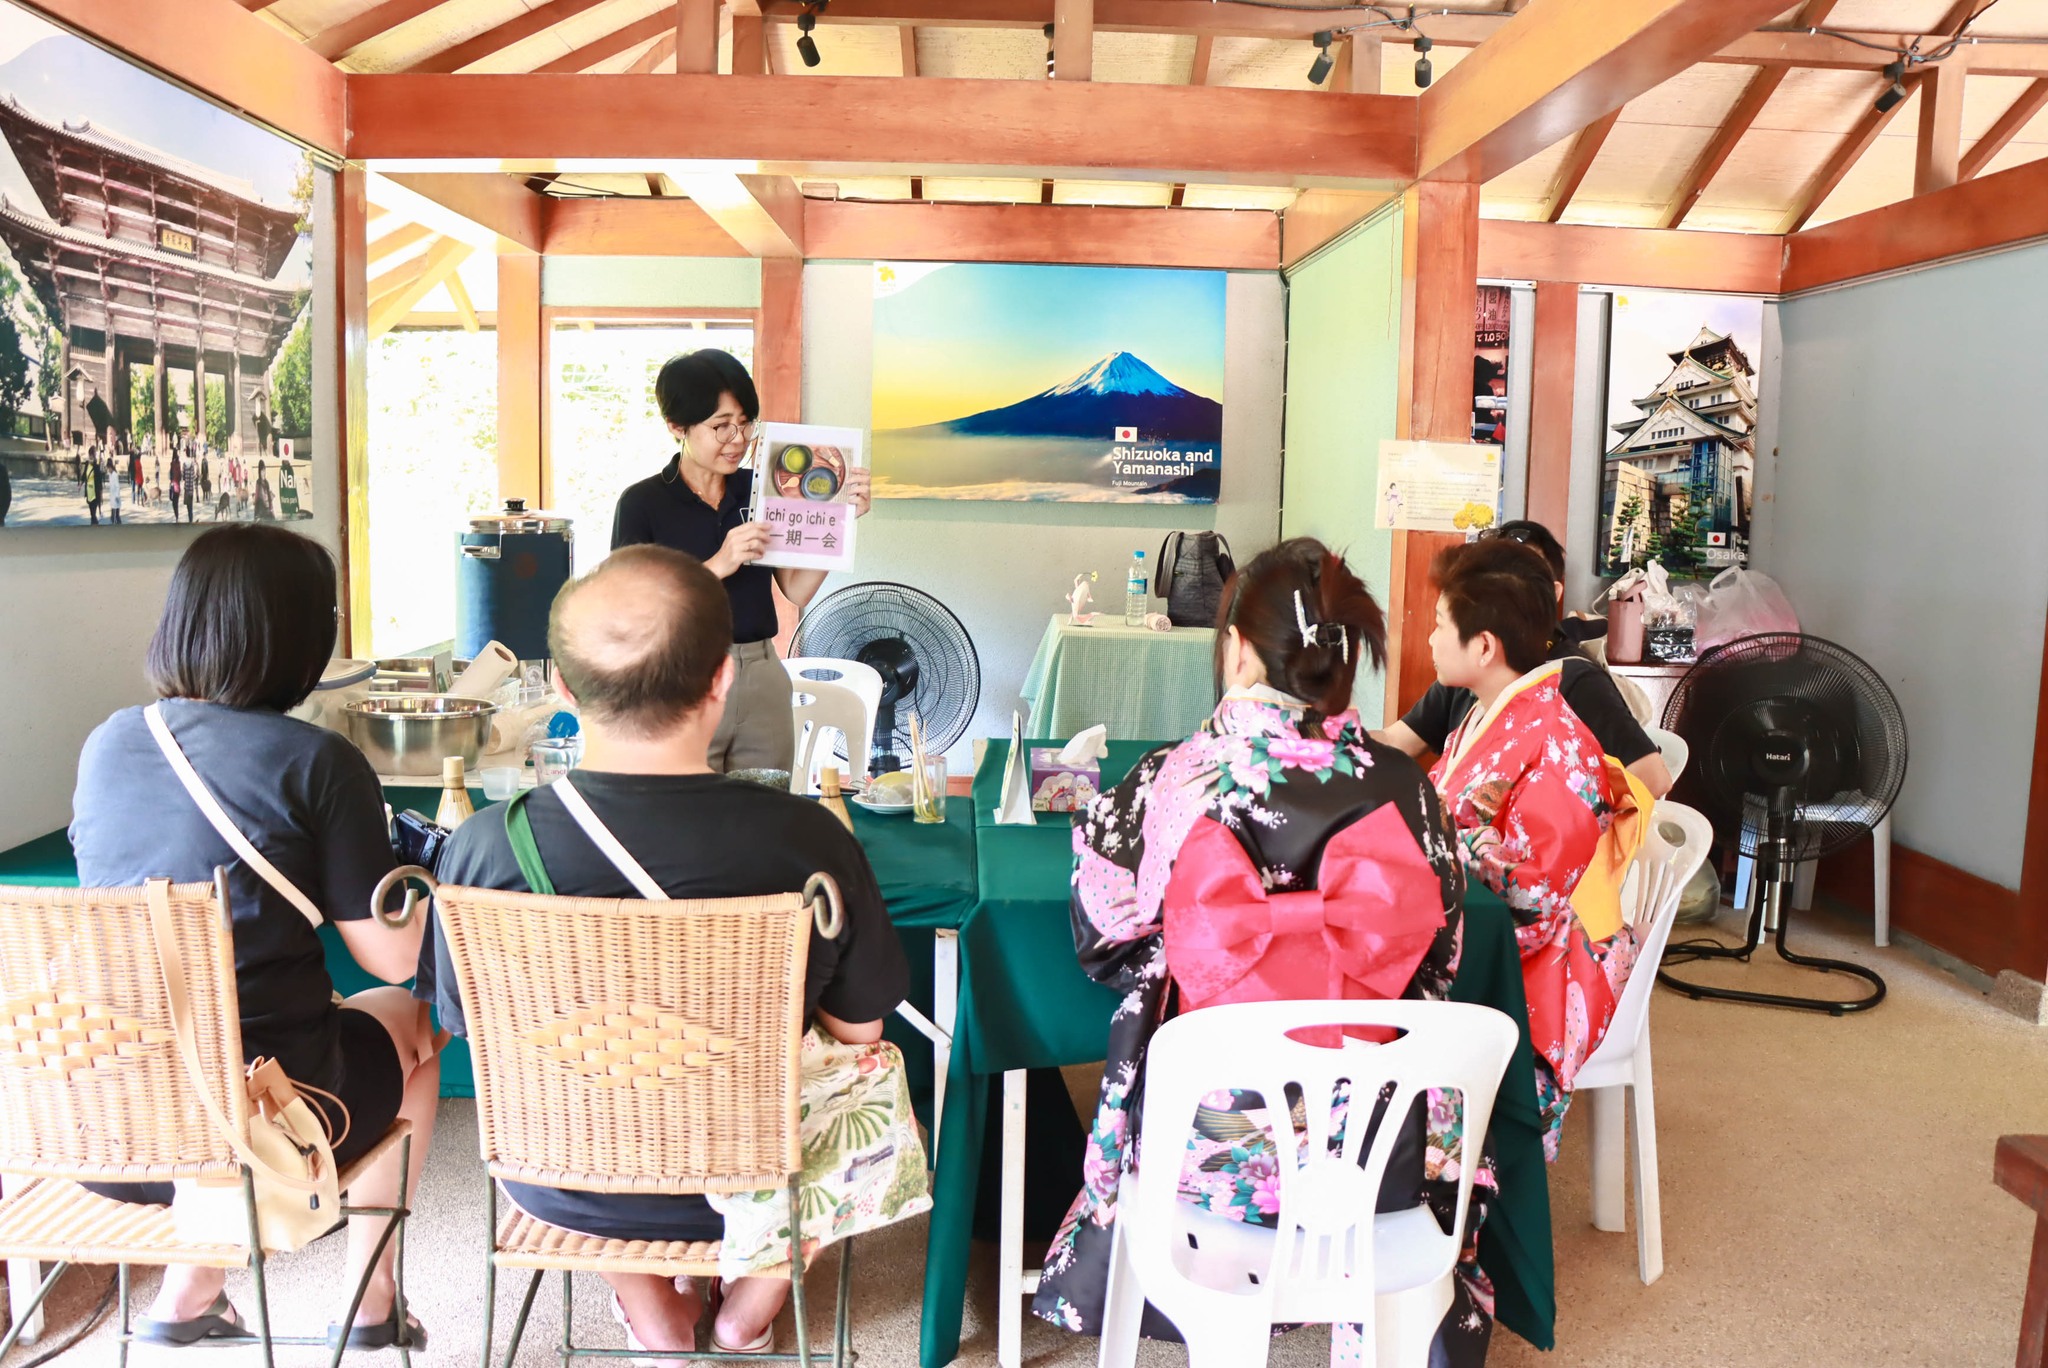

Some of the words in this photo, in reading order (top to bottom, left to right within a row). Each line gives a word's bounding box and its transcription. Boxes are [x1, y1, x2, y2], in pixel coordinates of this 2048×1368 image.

[1112, 446, 1181, 461] Shizuoka
[1185, 448, 1213, 462] and
[1112, 460, 1194, 476] Yamanashi
[1111, 480, 1122, 488] Fuji
[765, 507, 786, 522] ichi
[788, 512, 803, 527] go
[806, 510, 826, 525] ichi
[828, 515, 836, 526] e
[769, 529, 838, 549] 一期一会
[1706, 548, 1746, 560] Osaka
[1766, 752, 1791, 761] Hatari
